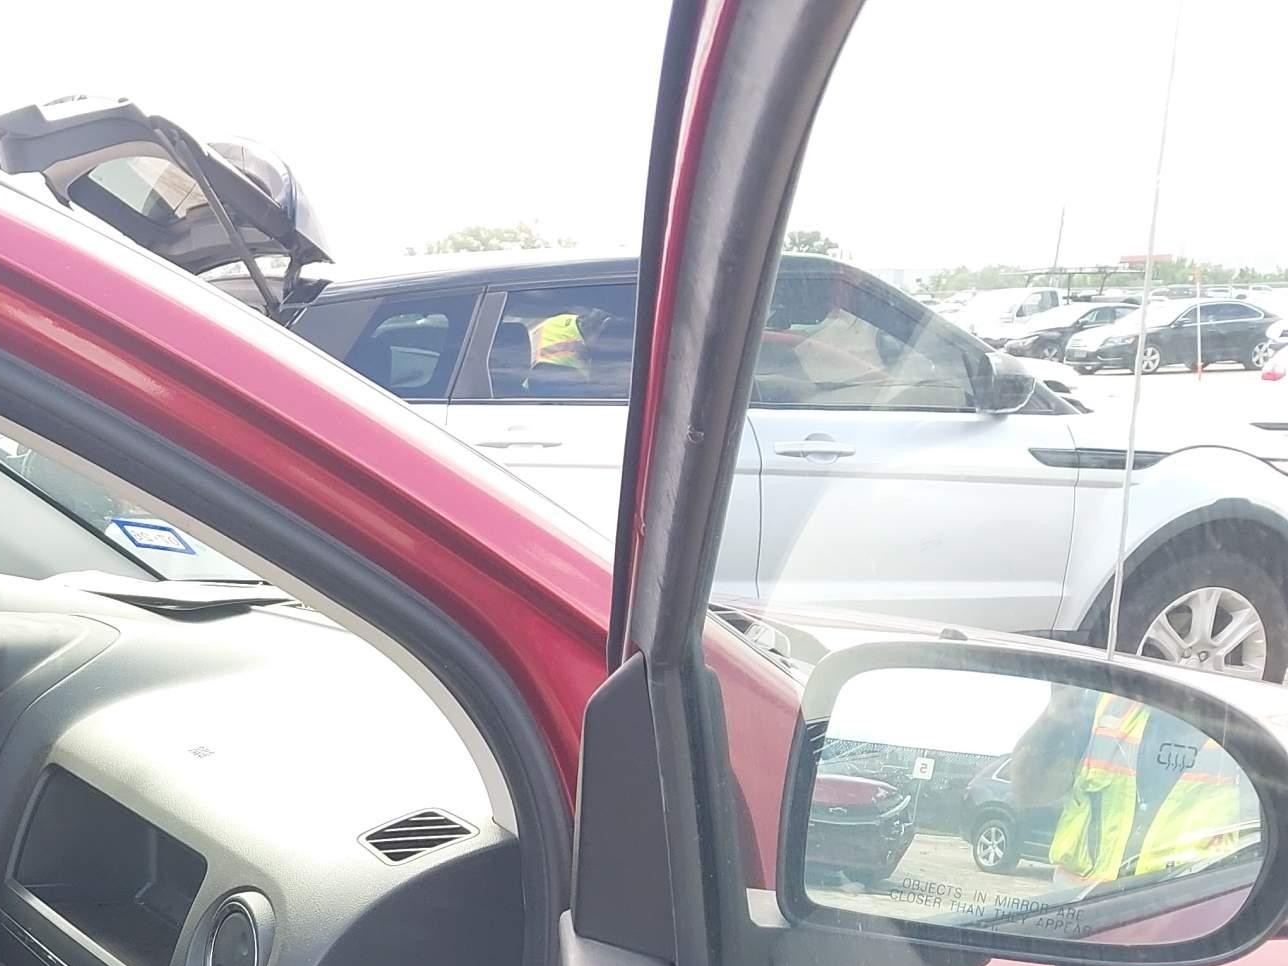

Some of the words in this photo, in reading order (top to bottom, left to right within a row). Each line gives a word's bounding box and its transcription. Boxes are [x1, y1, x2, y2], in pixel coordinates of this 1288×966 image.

[889, 888, 942, 908] CLOSER
[950, 900, 985, 917] THAN
[995, 908, 1031, 925] THEY
[1036, 917, 1092, 937] APPEAR
[901, 877, 962, 899] OBJECTS
[973, 891, 987, 903] IN
[994, 895, 1049, 914] MIRROR
[1057, 908, 1085, 921] ARE
